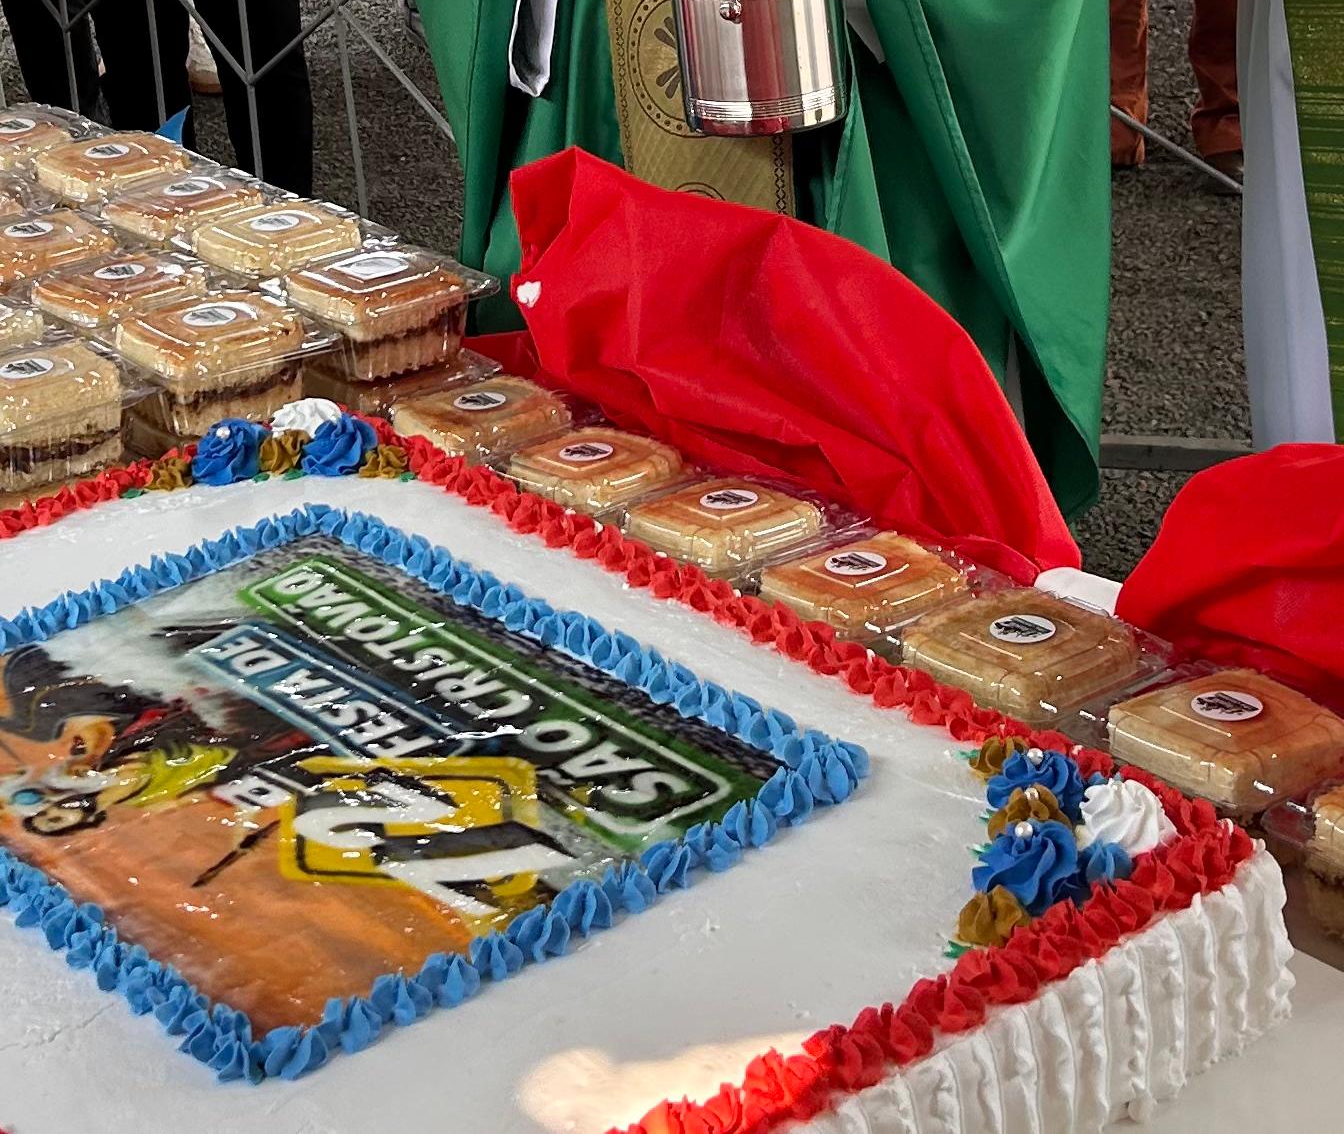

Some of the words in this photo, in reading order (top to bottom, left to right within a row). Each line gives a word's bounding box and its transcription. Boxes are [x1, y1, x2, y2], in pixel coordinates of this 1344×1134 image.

[210, 635, 289, 678] DE
[267, 668, 437, 759] FESTA
[517, 719, 690, 807] SÃO
